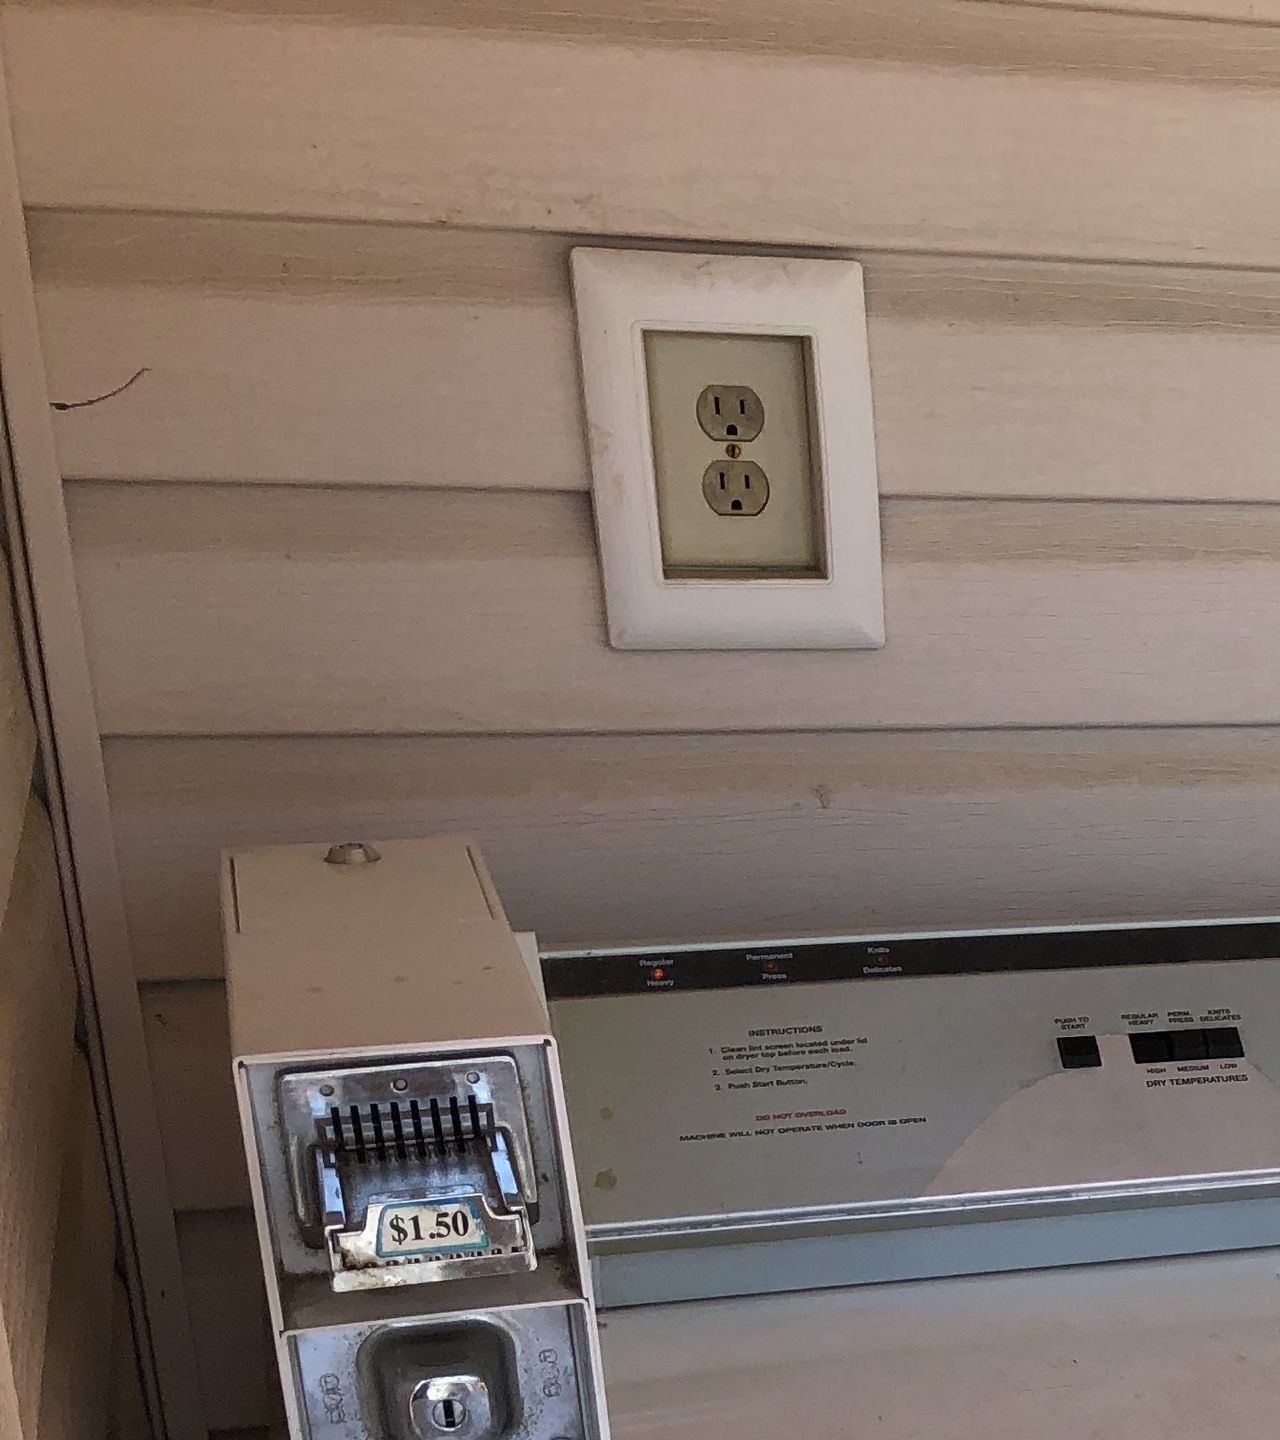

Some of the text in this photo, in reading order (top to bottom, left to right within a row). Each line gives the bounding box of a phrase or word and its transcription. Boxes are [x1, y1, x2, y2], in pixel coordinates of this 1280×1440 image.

[746, 952, 793, 961] Permanent
[639, 958, 674, 967] Regular
[862, 965, 903, 974] Delicates
[762, 972, 787, 981] Press
[1121, 1012, 1159, 1020] REGULAR
[1168, 1016, 1194, 1024] PRESS
[1200, 1014, 1242, 1023] DELICATES
[1054, 1017, 1076, 1025] PUSH
[748, 1025, 823, 1037] INSTRUCTIONS
[1060, 1023, 1086, 1031] START
[721, 1045, 747, 1054] Clean
[748, 1044, 762, 1052] lint
[764, 1042, 794, 1050] screen
[795, 1039, 828, 1048] located
[830, 1038, 855, 1046] under
[736, 1052, 758, 1061] dryer
[761, 1051, 776, 1059] top
[778, 1049, 806, 1057] before
[808, 1047, 829, 1055] each
[725, 1067, 753, 1075] Select
[754, 1065, 770, 1074] Dry
[1177, 1064, 1210, 1072] MEDIUM
[728, 1082, 750, 1090] Push
[752, 1080, 774, 1088] Start
[1146, 1073, 1249, 1088] DRY TEMPERATURES
[756, 1108, 847, 1122] DO NOT OVERLOAD
[679, 1132, 726, 1142] MACHINE
[729, 1130, 752, 1138] WILL
[754, 1127, 775, 1136] NOT
[778, 1124, 823, 1134] OPERATE
[825, 1122, 855, 1130] WHEN
[857, 1119, 886, 1128] DOOR
[899, 1116, 927, 1125] OPEN
[389, 1210, 469, 1245] $1.50
